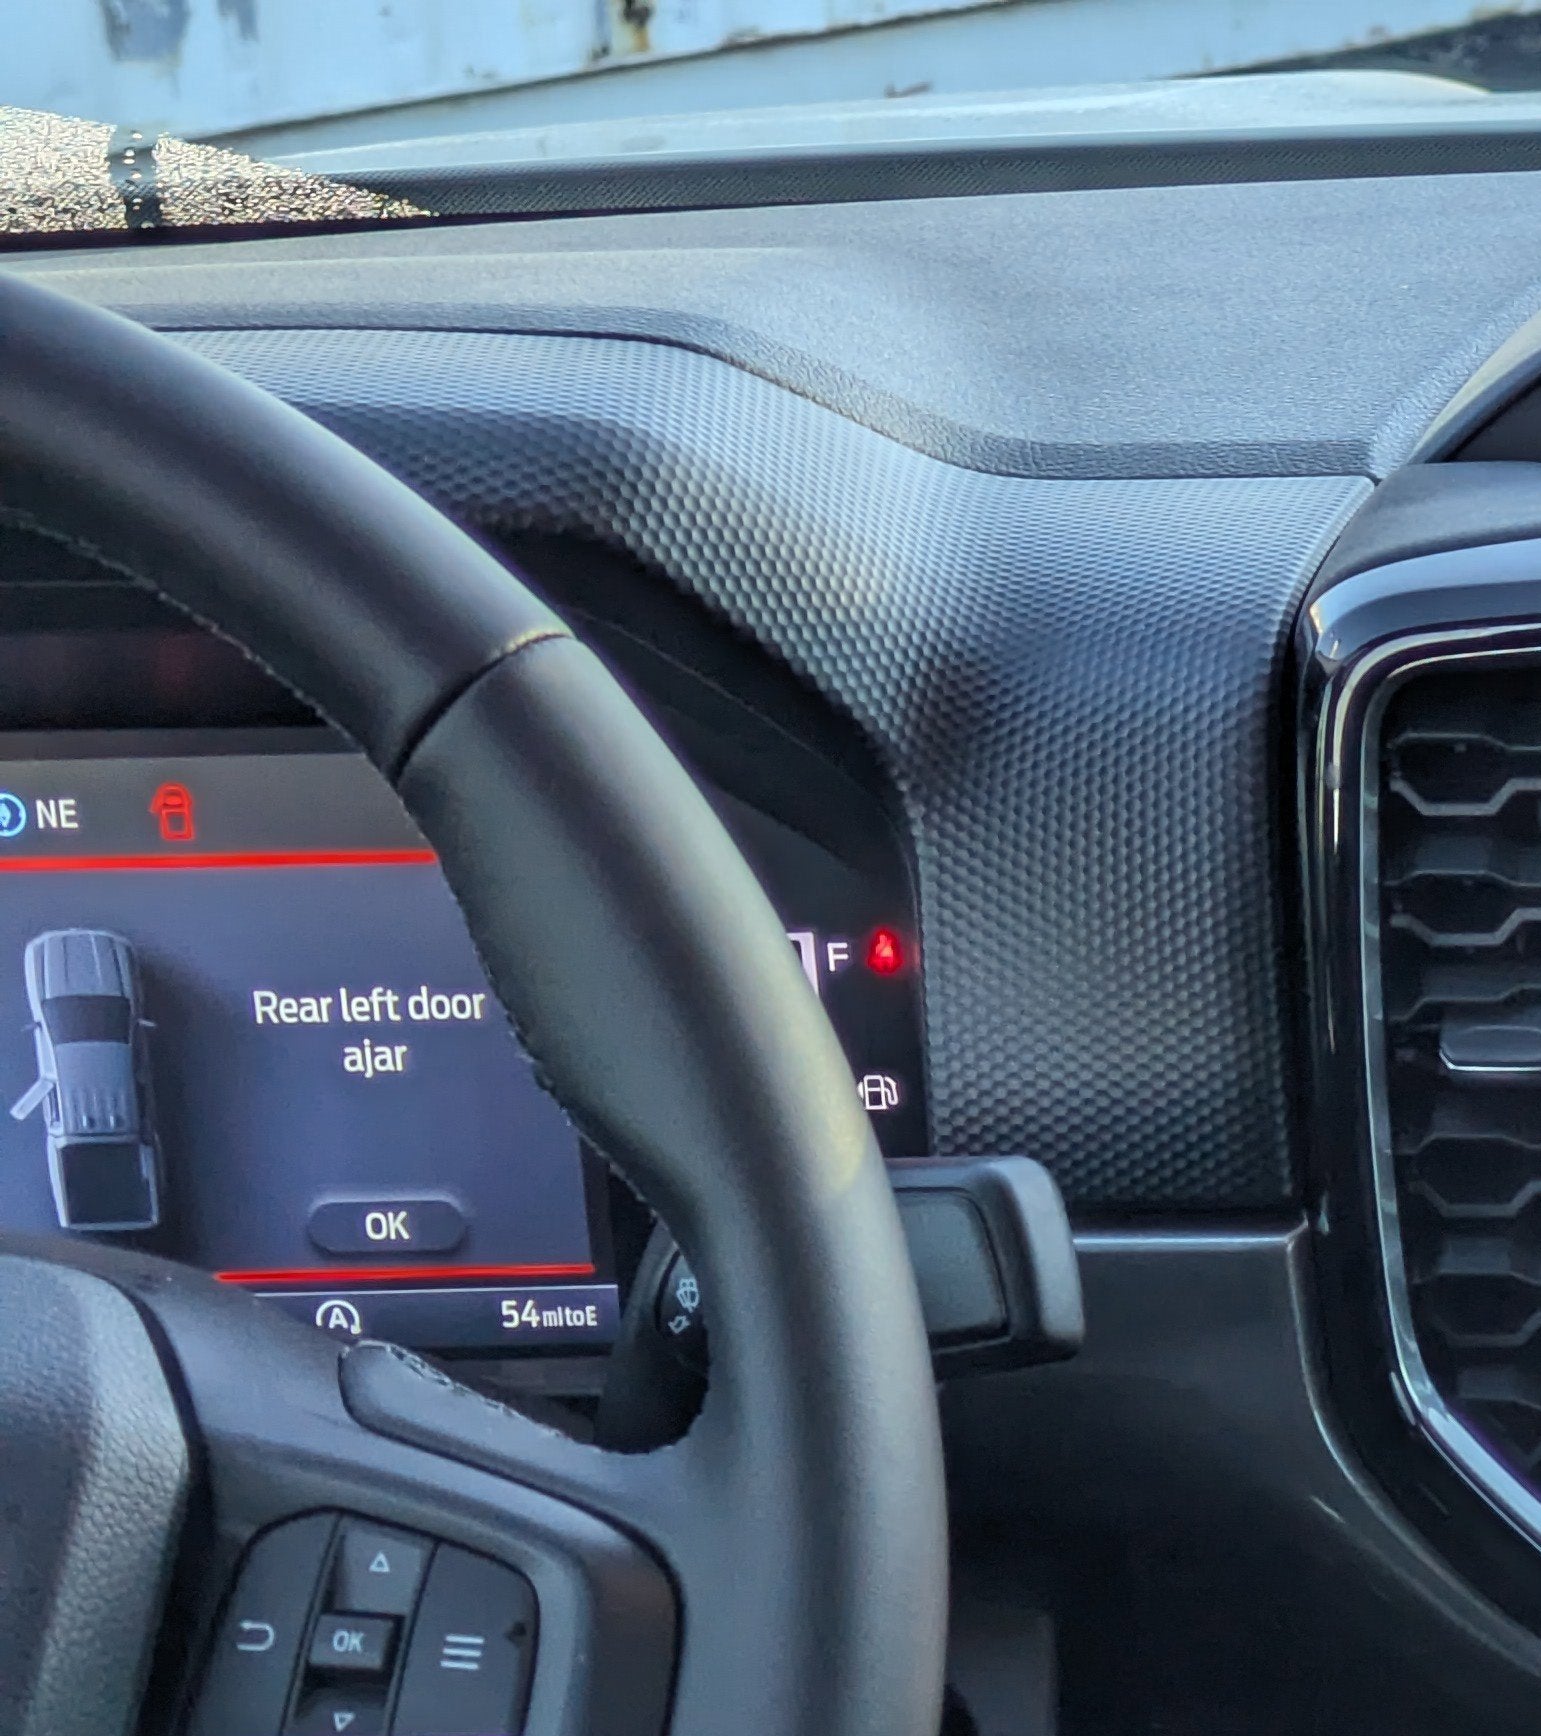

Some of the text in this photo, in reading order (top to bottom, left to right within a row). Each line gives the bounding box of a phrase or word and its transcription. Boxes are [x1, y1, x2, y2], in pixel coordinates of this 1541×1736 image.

[36, 799, 79, 829] NE
[827, 942, 849, 972] F
[254, 986, 486, 1024] Rear left door
[343, 1042, 408, 1078] ajar
[365, 1210, 411, 1243] OK
[501, 1299, 540, 1328] 54
[332, 1629, 364, 1653] OK
